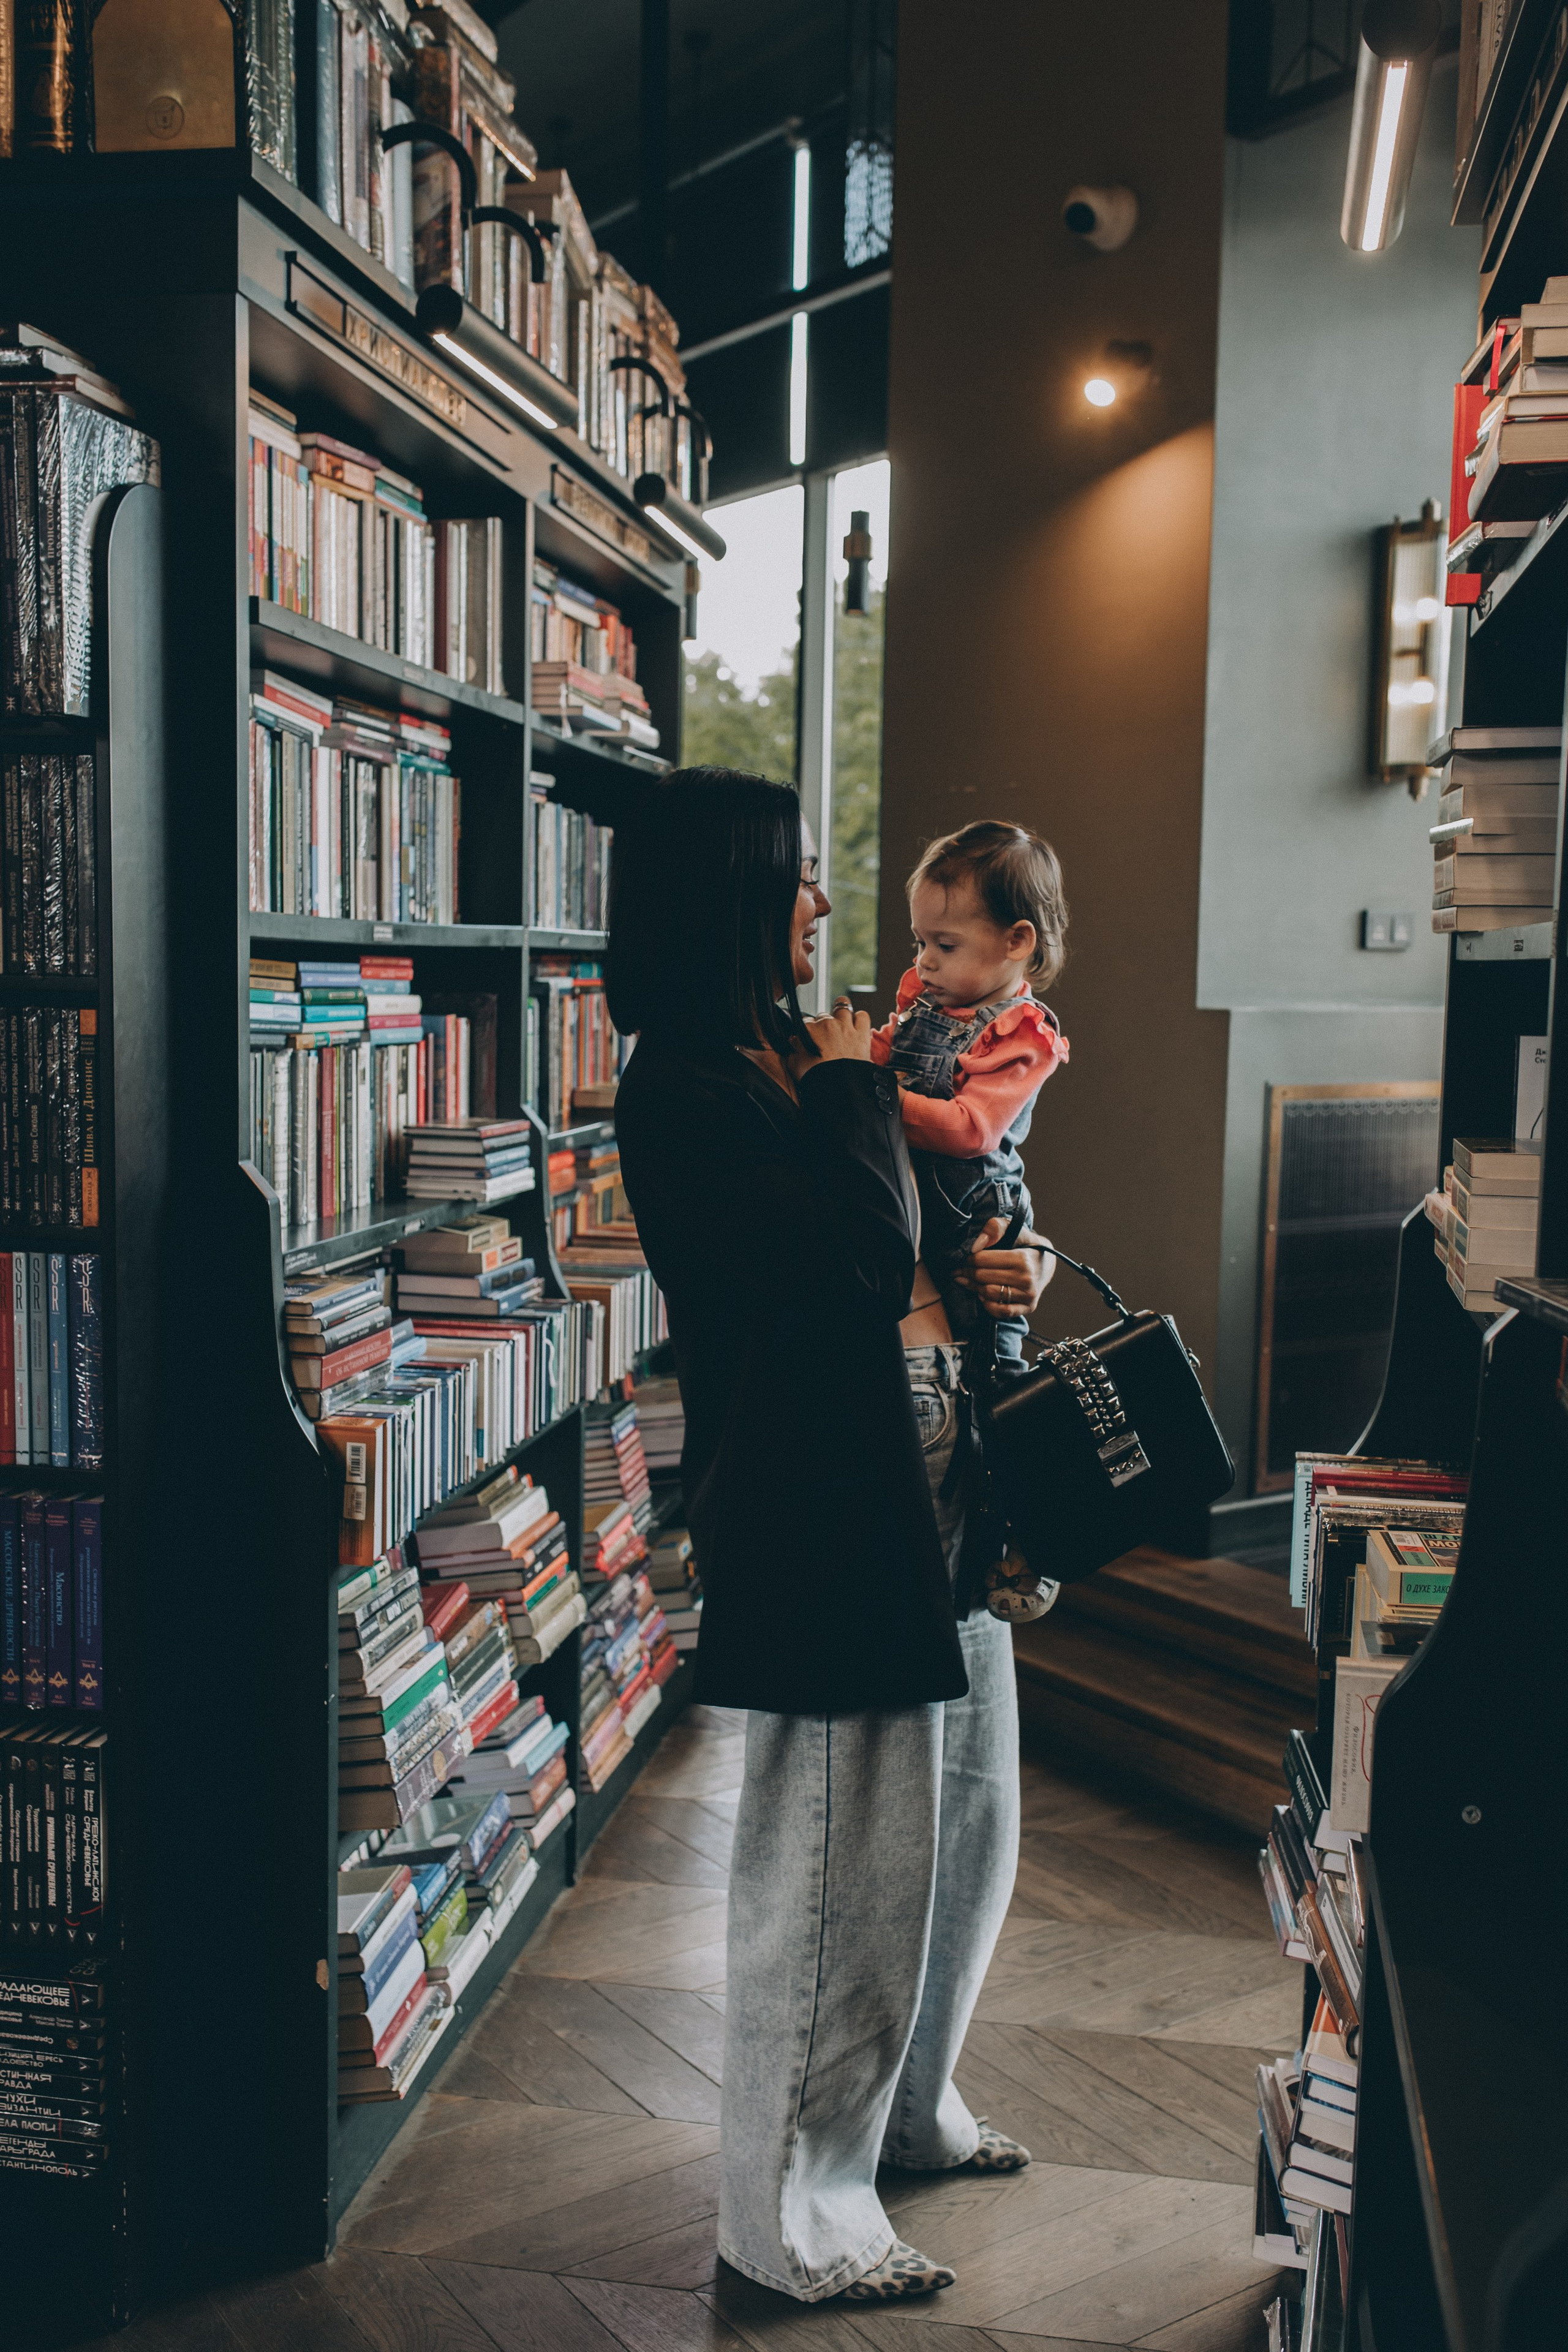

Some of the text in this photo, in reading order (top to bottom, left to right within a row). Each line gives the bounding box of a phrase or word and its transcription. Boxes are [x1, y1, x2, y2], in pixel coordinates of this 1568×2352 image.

[82, 1059, 95, 1109] Дионис
[30, 1104, 39, 1163] Антон Соколов
[4, 1530, 15, 1661] МАСОНСКИЕ ДРЕВНОСТИ
[55, 1572, 66, 1626] Масонство
[1406, 1584, 1412, 1593] О
[1412, 1584, 1431, 1594] ДУХЕ
[83, 1815, 92, 1887] СРЕДНЕВЕКОВЬЕ
[36, 2054, 64, 2064] ЕРЕСЬ
[21, 2120, 56, 2133] ПЛОТИ
